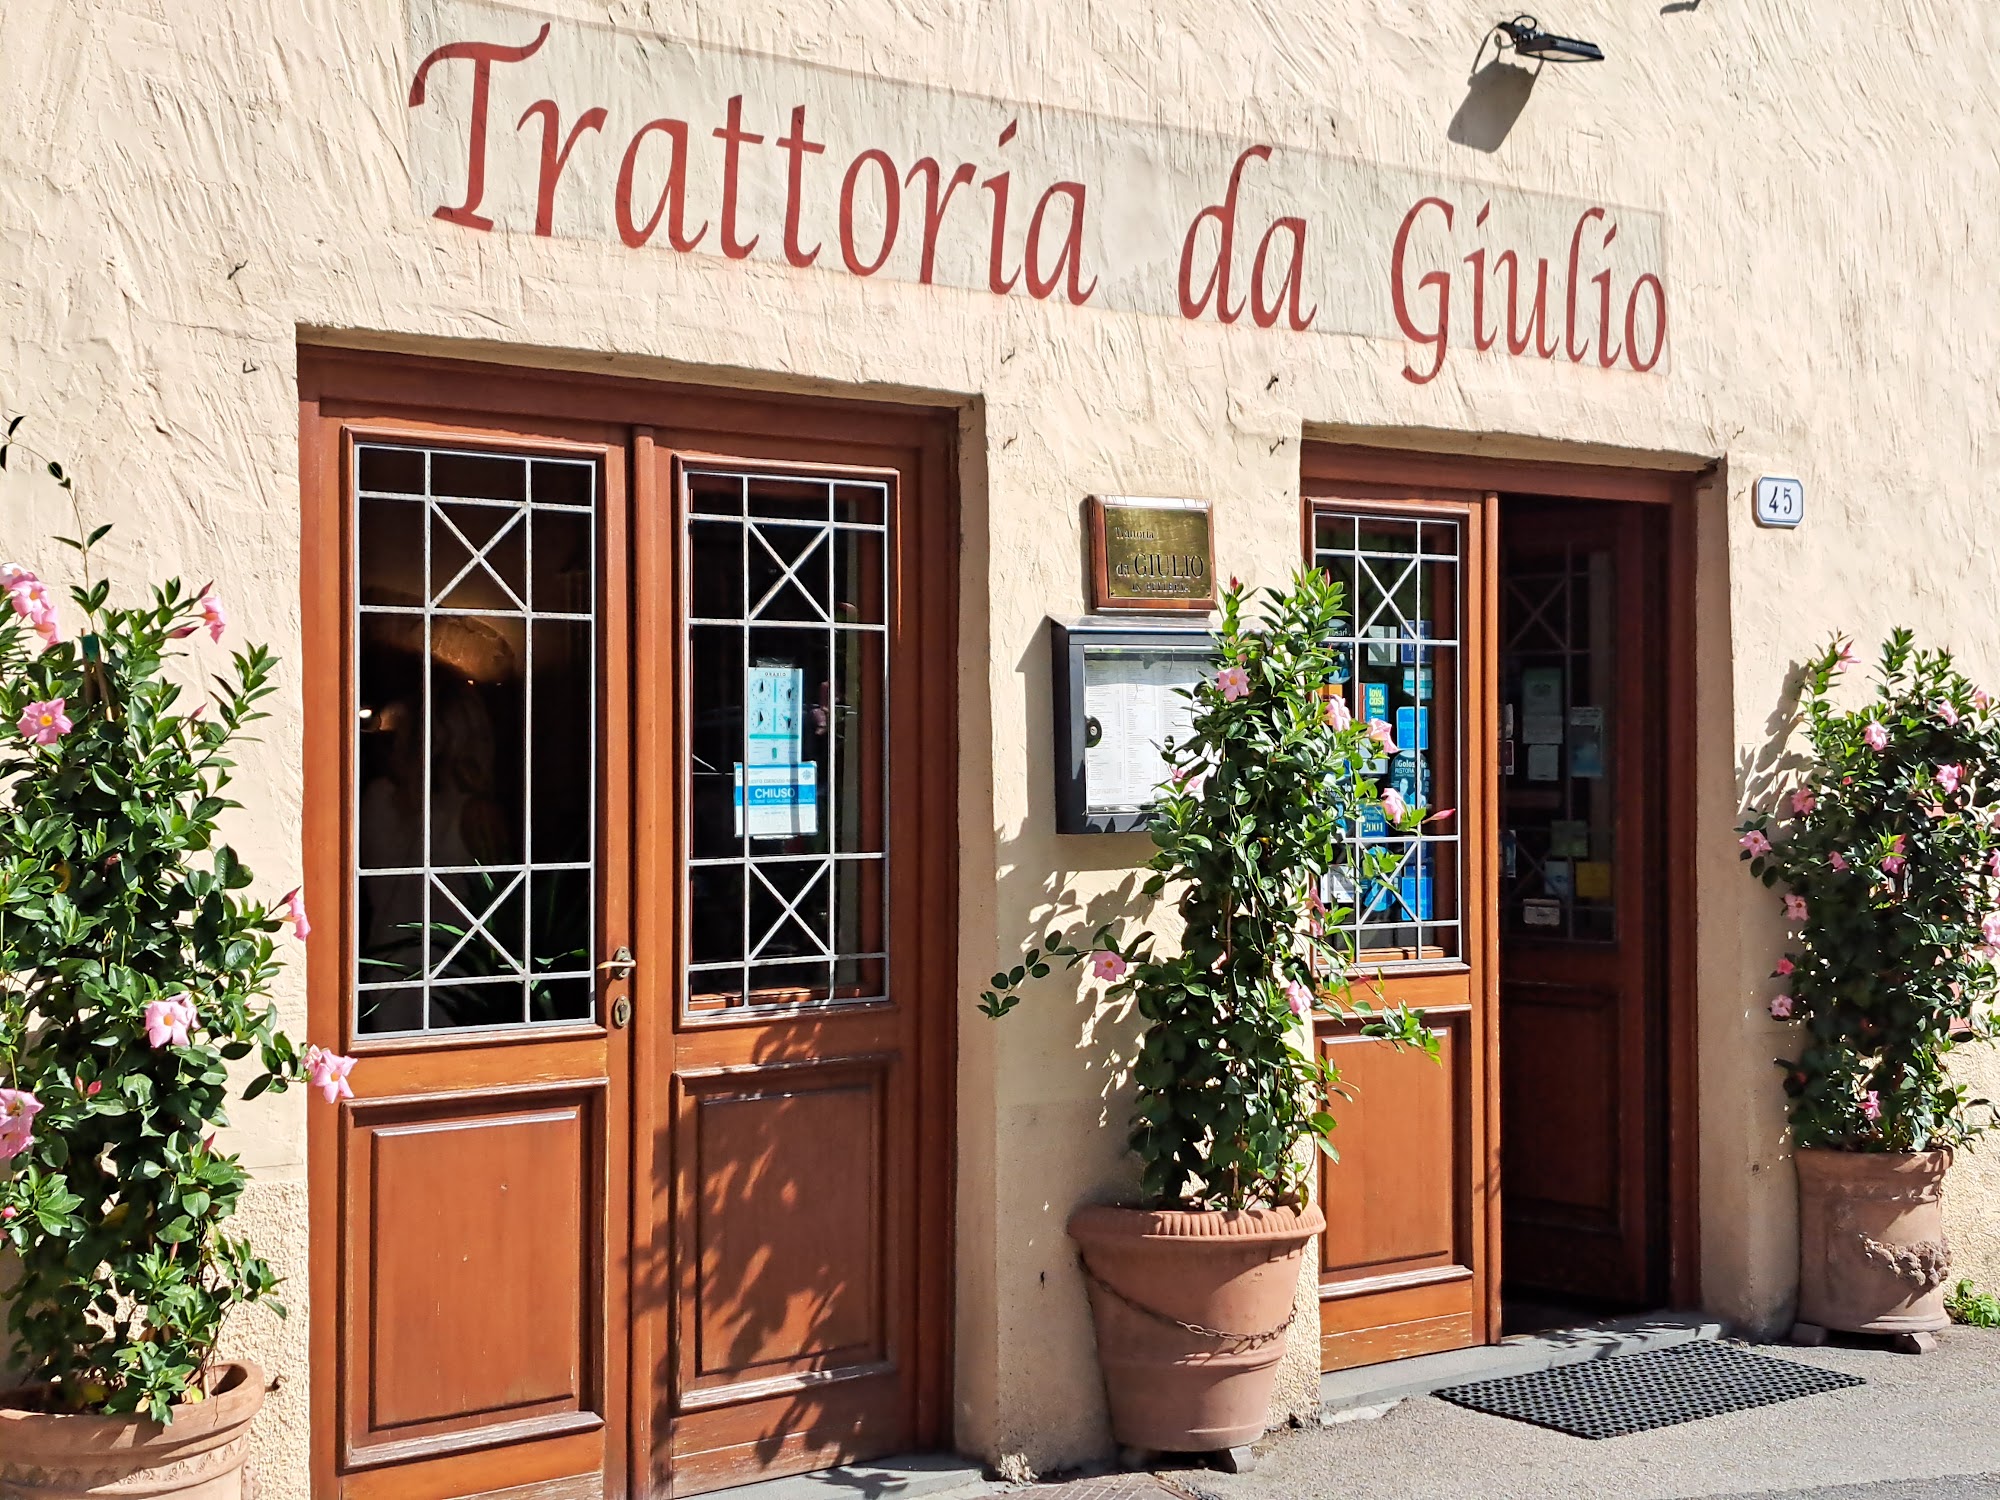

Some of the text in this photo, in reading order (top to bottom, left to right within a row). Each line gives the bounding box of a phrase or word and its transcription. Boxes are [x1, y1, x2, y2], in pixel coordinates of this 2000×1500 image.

[409, 24, 1666, 385] Trattoria da Giulio
[1768, 486, 1792, 514] 45
[1116, 553, 1204, 578] da GIULIO
[755, 788, 796, 799] CHIUSO
[1363, 821, 1384, 833] 2001
